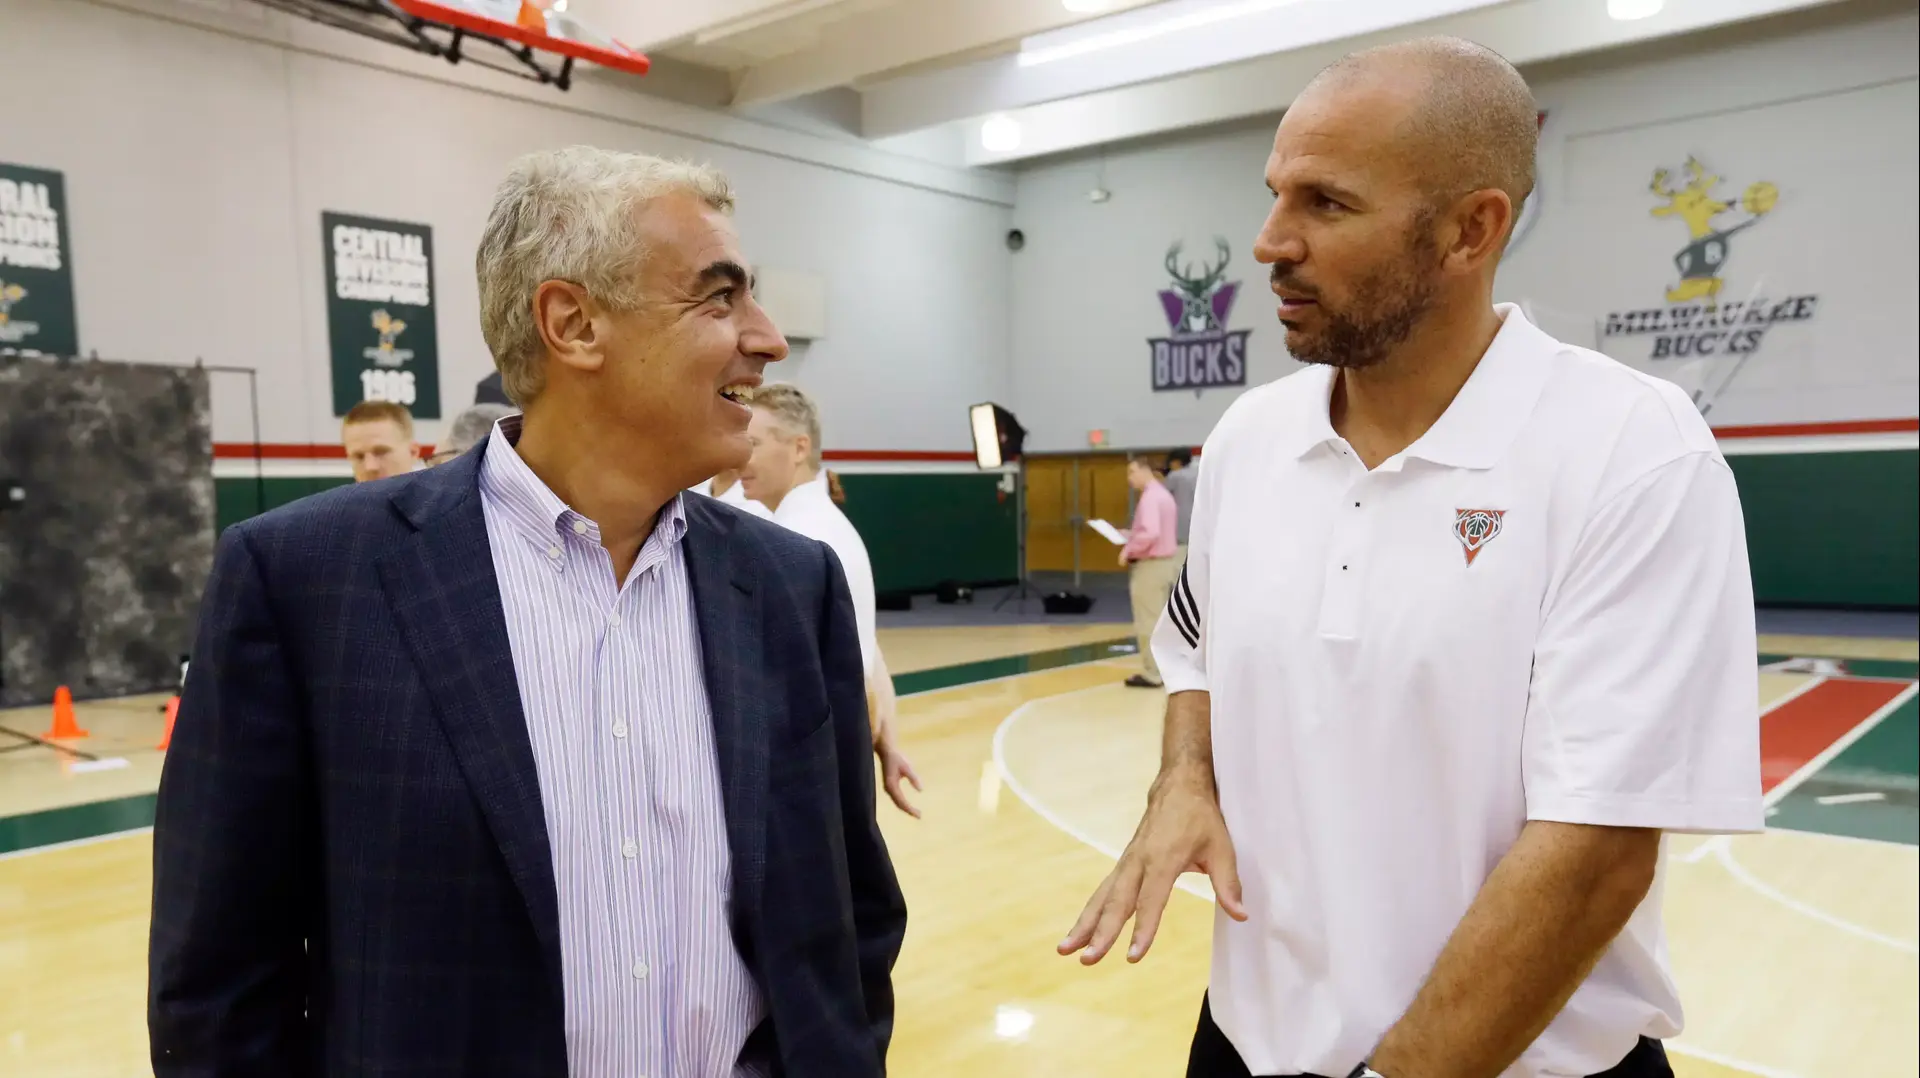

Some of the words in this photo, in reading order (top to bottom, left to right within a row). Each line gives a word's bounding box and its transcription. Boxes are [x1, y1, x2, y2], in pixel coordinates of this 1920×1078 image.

[333, 224, 427, 261] CENTRAL
[335, 250, 428, 283] DIVISION
[1605, 294, 1818, 335] MILWAUKEE
[1155, 335, 1242, 386] BUCKS
